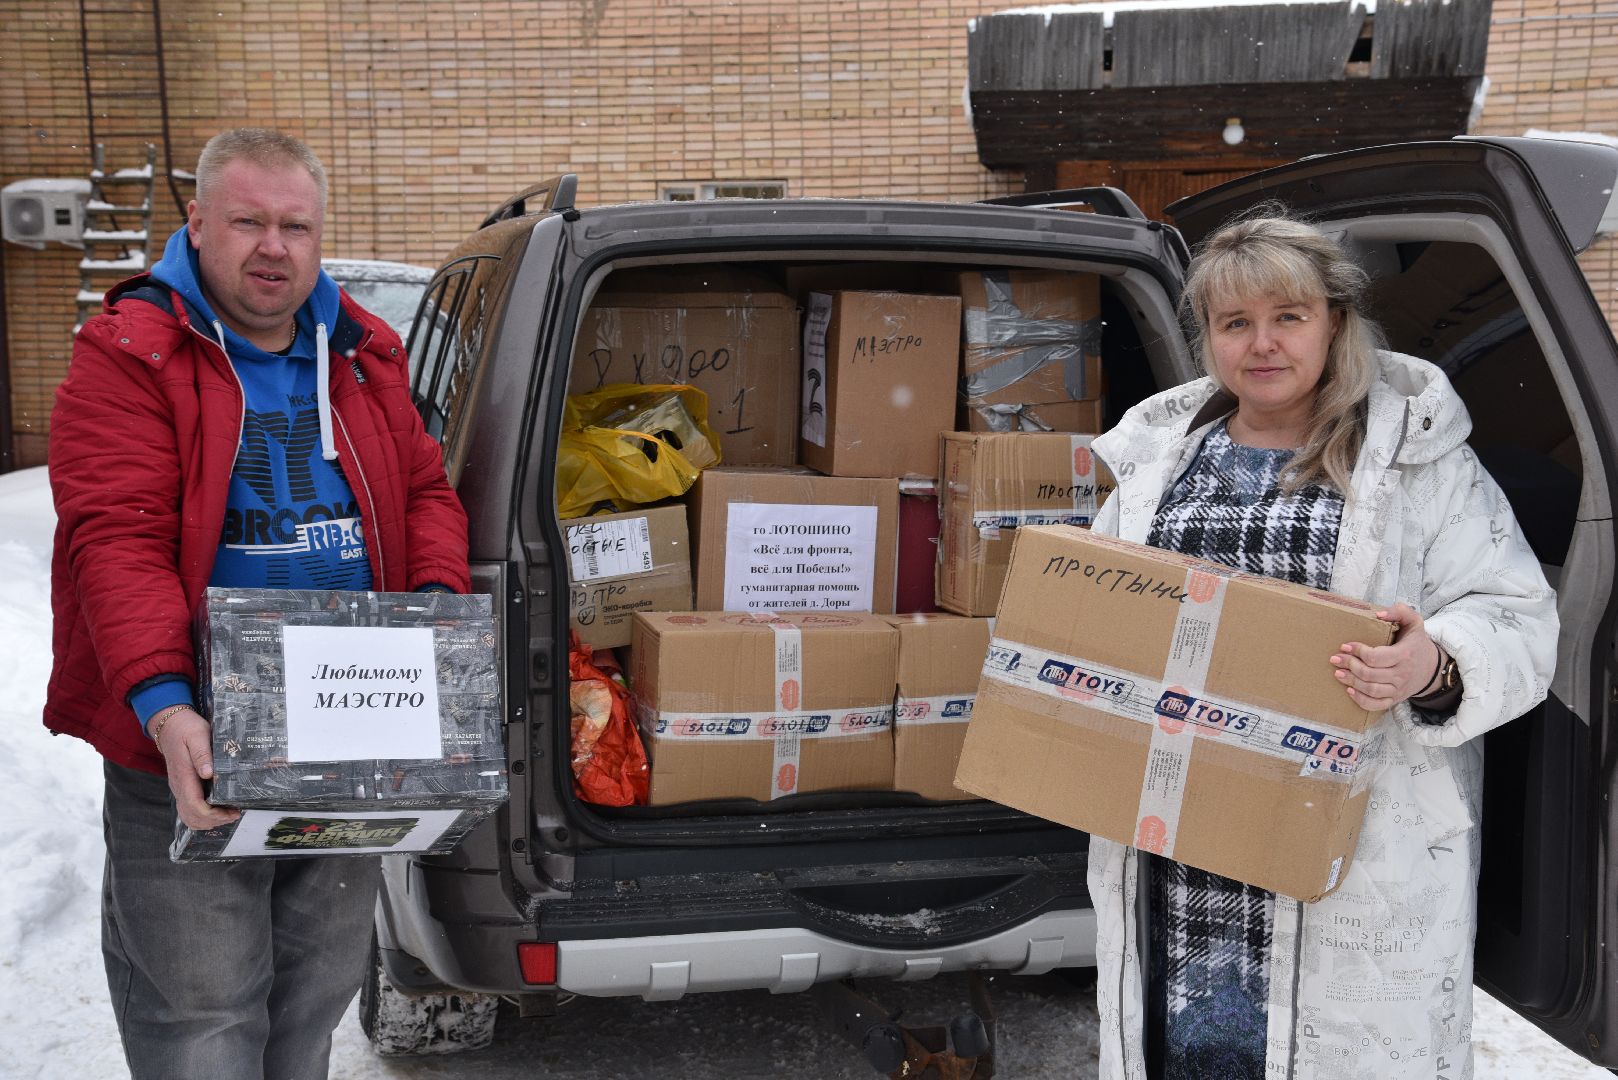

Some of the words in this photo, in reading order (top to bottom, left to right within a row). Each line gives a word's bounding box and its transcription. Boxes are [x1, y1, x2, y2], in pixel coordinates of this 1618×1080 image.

[753, 526, 766, 535] го
[769, 524, 851, 535] ЛОТОШИНО
[753, 544, 780, 555] «Всё
[783, 546, 804, 555] для
[807, 544, 853, 556] фронта,
[750, 563, 769, 574] всё
[772, 565, 793, 574] для
[796, 563, 851, 575] Победы!»
[740, 584, 815, 595] гуманитарная
[818, 584, 860, 593] помощь
[748, 600, 760, 609] от
[762, 597, 807, 609] жителей
[823, 597, 850, 610] Доры
[311, 663, 423, 684] Любимому
[1073, 671, 1126, 697] TOYS
[312, 691, 425, 709] МАЭСТРО
[1194, 704, 1250, 731] TOYS
[688, 722, 726, 732] TOYS
[1410, 762, 1428, 777] ZE
[327, 821, 367, 832] 23
[276, 826, 404, 844] ФЕВРАЛЯ
